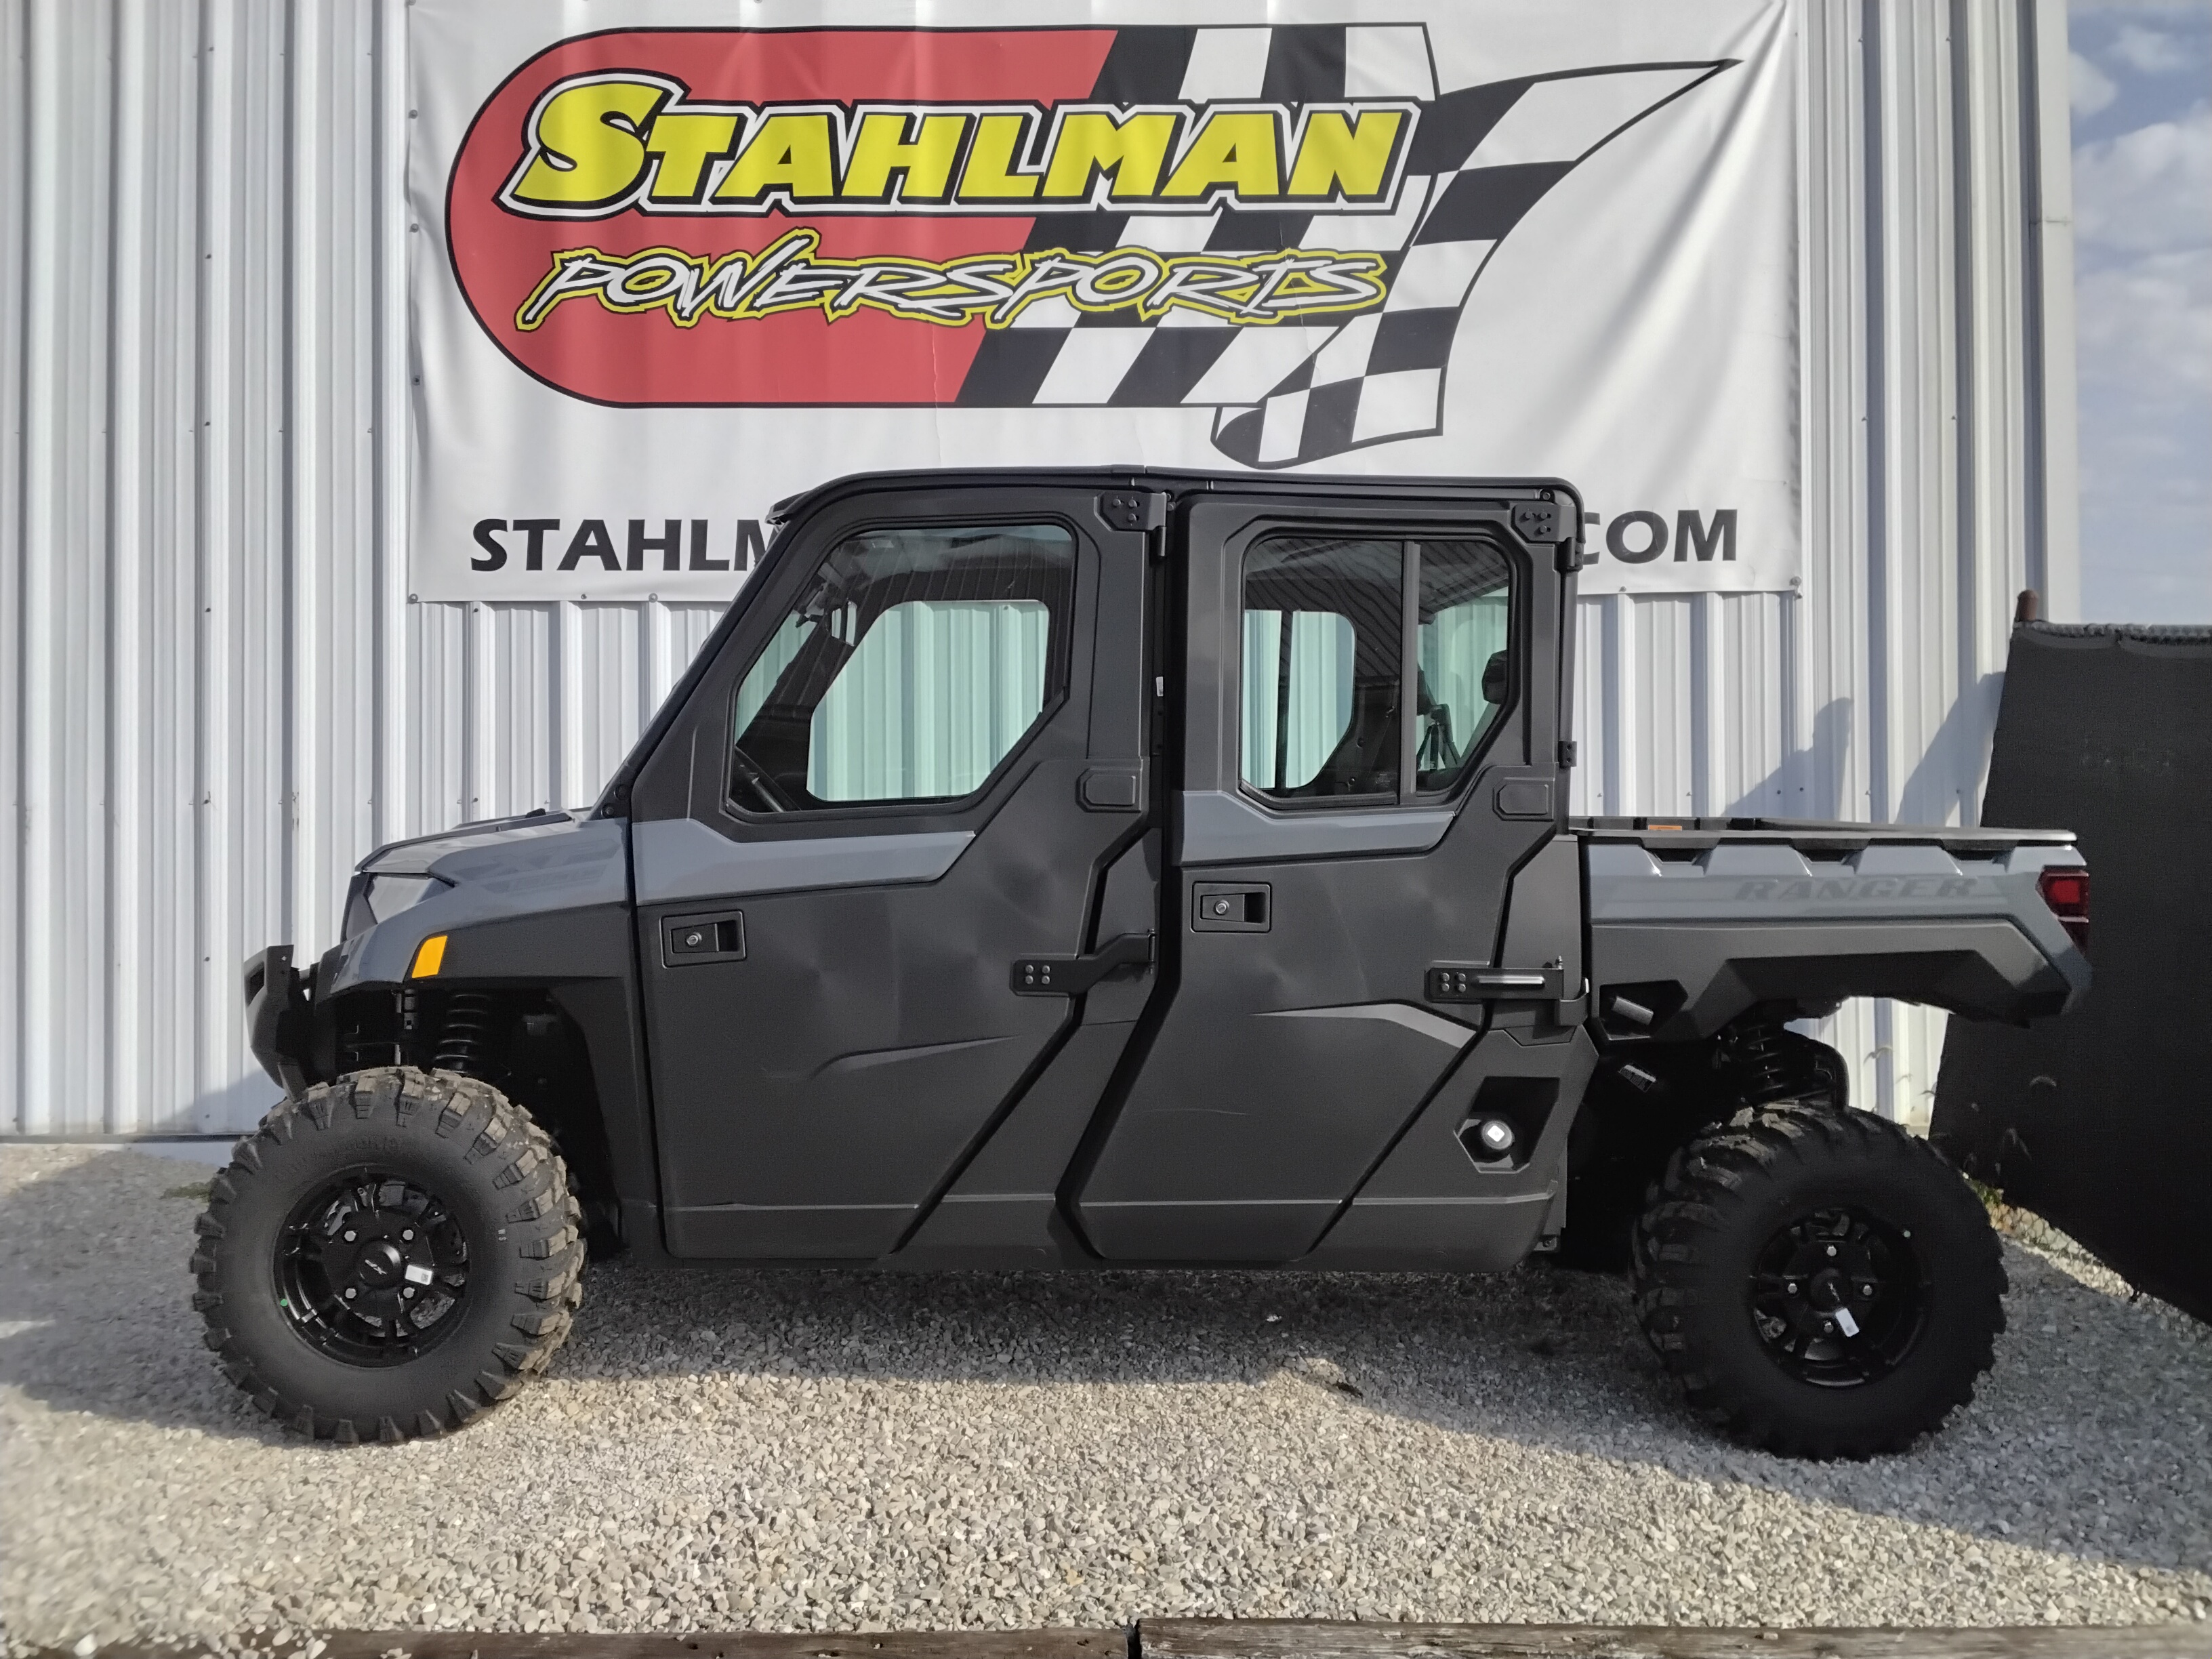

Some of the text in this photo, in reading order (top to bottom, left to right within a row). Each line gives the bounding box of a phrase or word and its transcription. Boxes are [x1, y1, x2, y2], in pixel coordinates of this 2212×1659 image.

[497, 72, 1421, 218] STAHLMAN
[516, 228, 1386, 330] POWERSPORTS
[1734, 878, 1978, 901] RANGER
